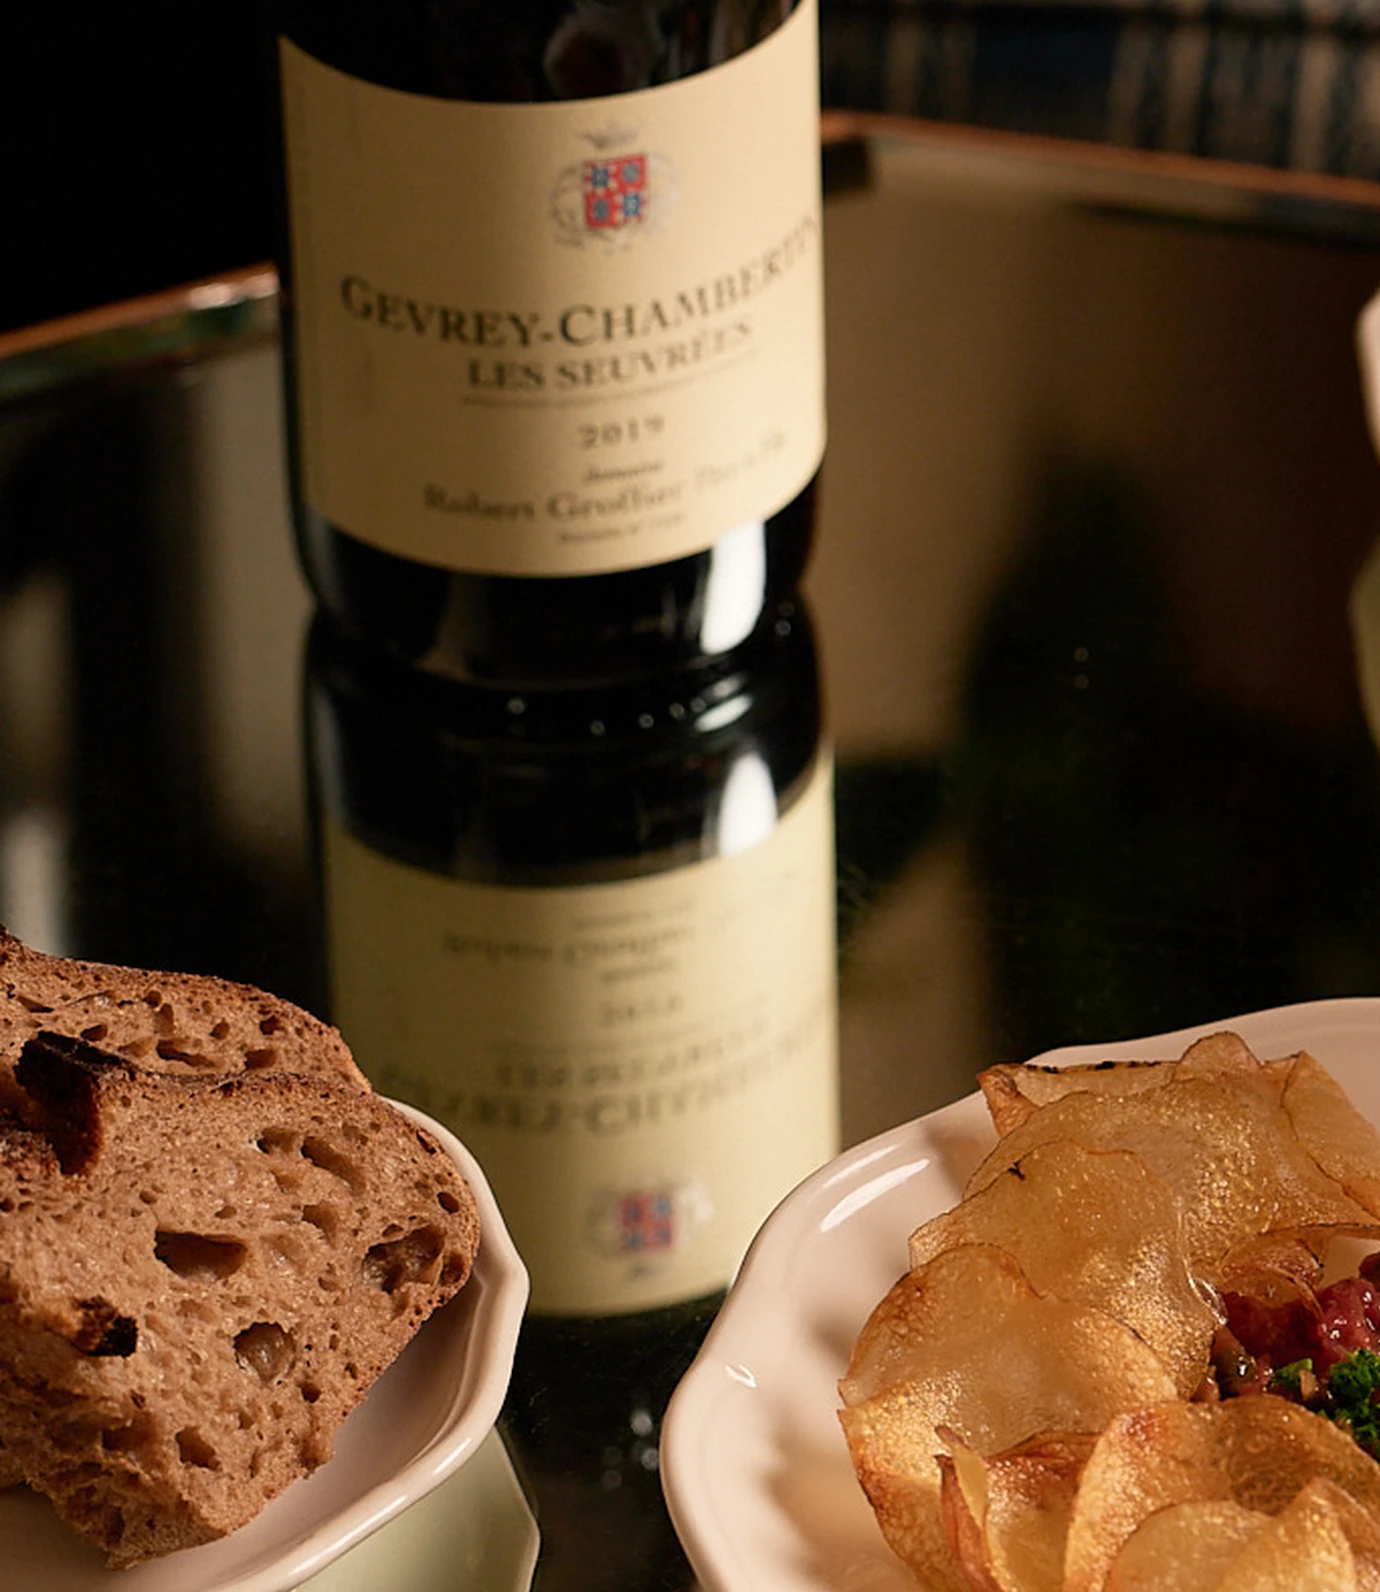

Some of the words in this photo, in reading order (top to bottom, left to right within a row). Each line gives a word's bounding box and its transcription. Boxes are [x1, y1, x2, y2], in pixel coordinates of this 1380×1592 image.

[468, 357, 545, 390] LES
[556, 316, 752, 391] SEUVRÉES
[578, 413, 666, 449] 2019
